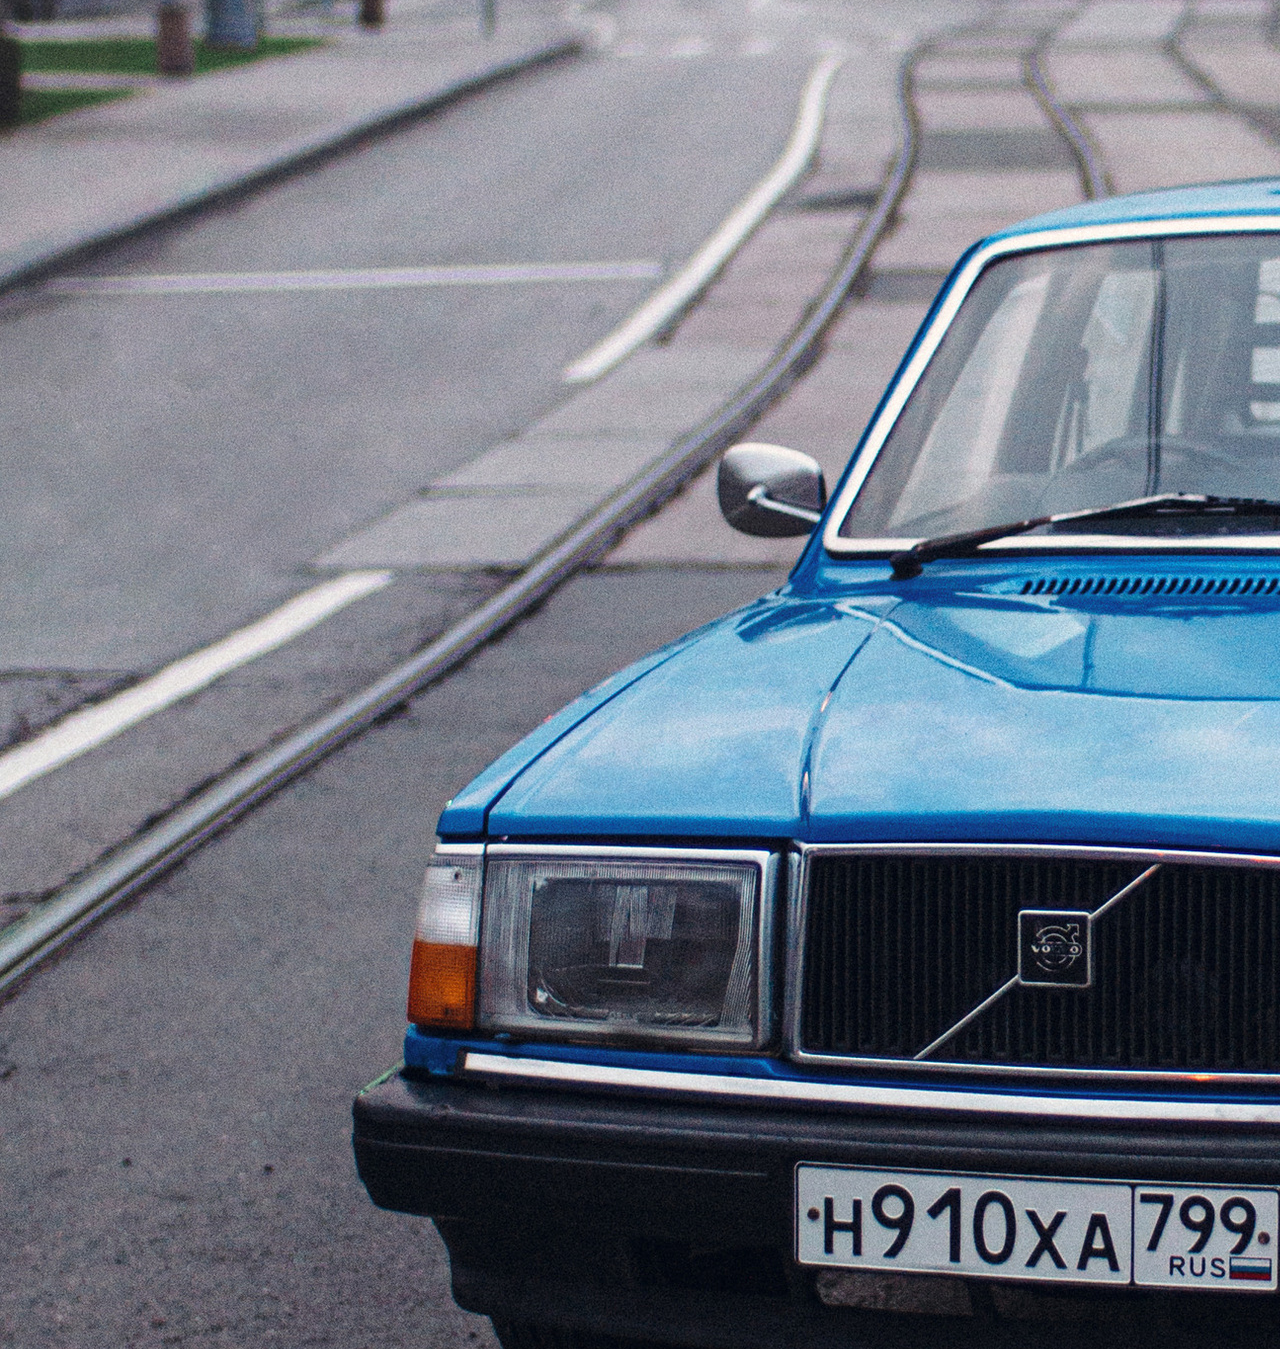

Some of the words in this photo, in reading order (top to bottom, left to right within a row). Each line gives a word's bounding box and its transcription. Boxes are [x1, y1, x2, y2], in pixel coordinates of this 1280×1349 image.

[1030, 944, 1080, 955] VOO
[823, 1183, 1121, 1272] Н910ХА
[1139, 1193, 1257, 1254] 799
[1169, 1255, 1226, 1278] RUS
